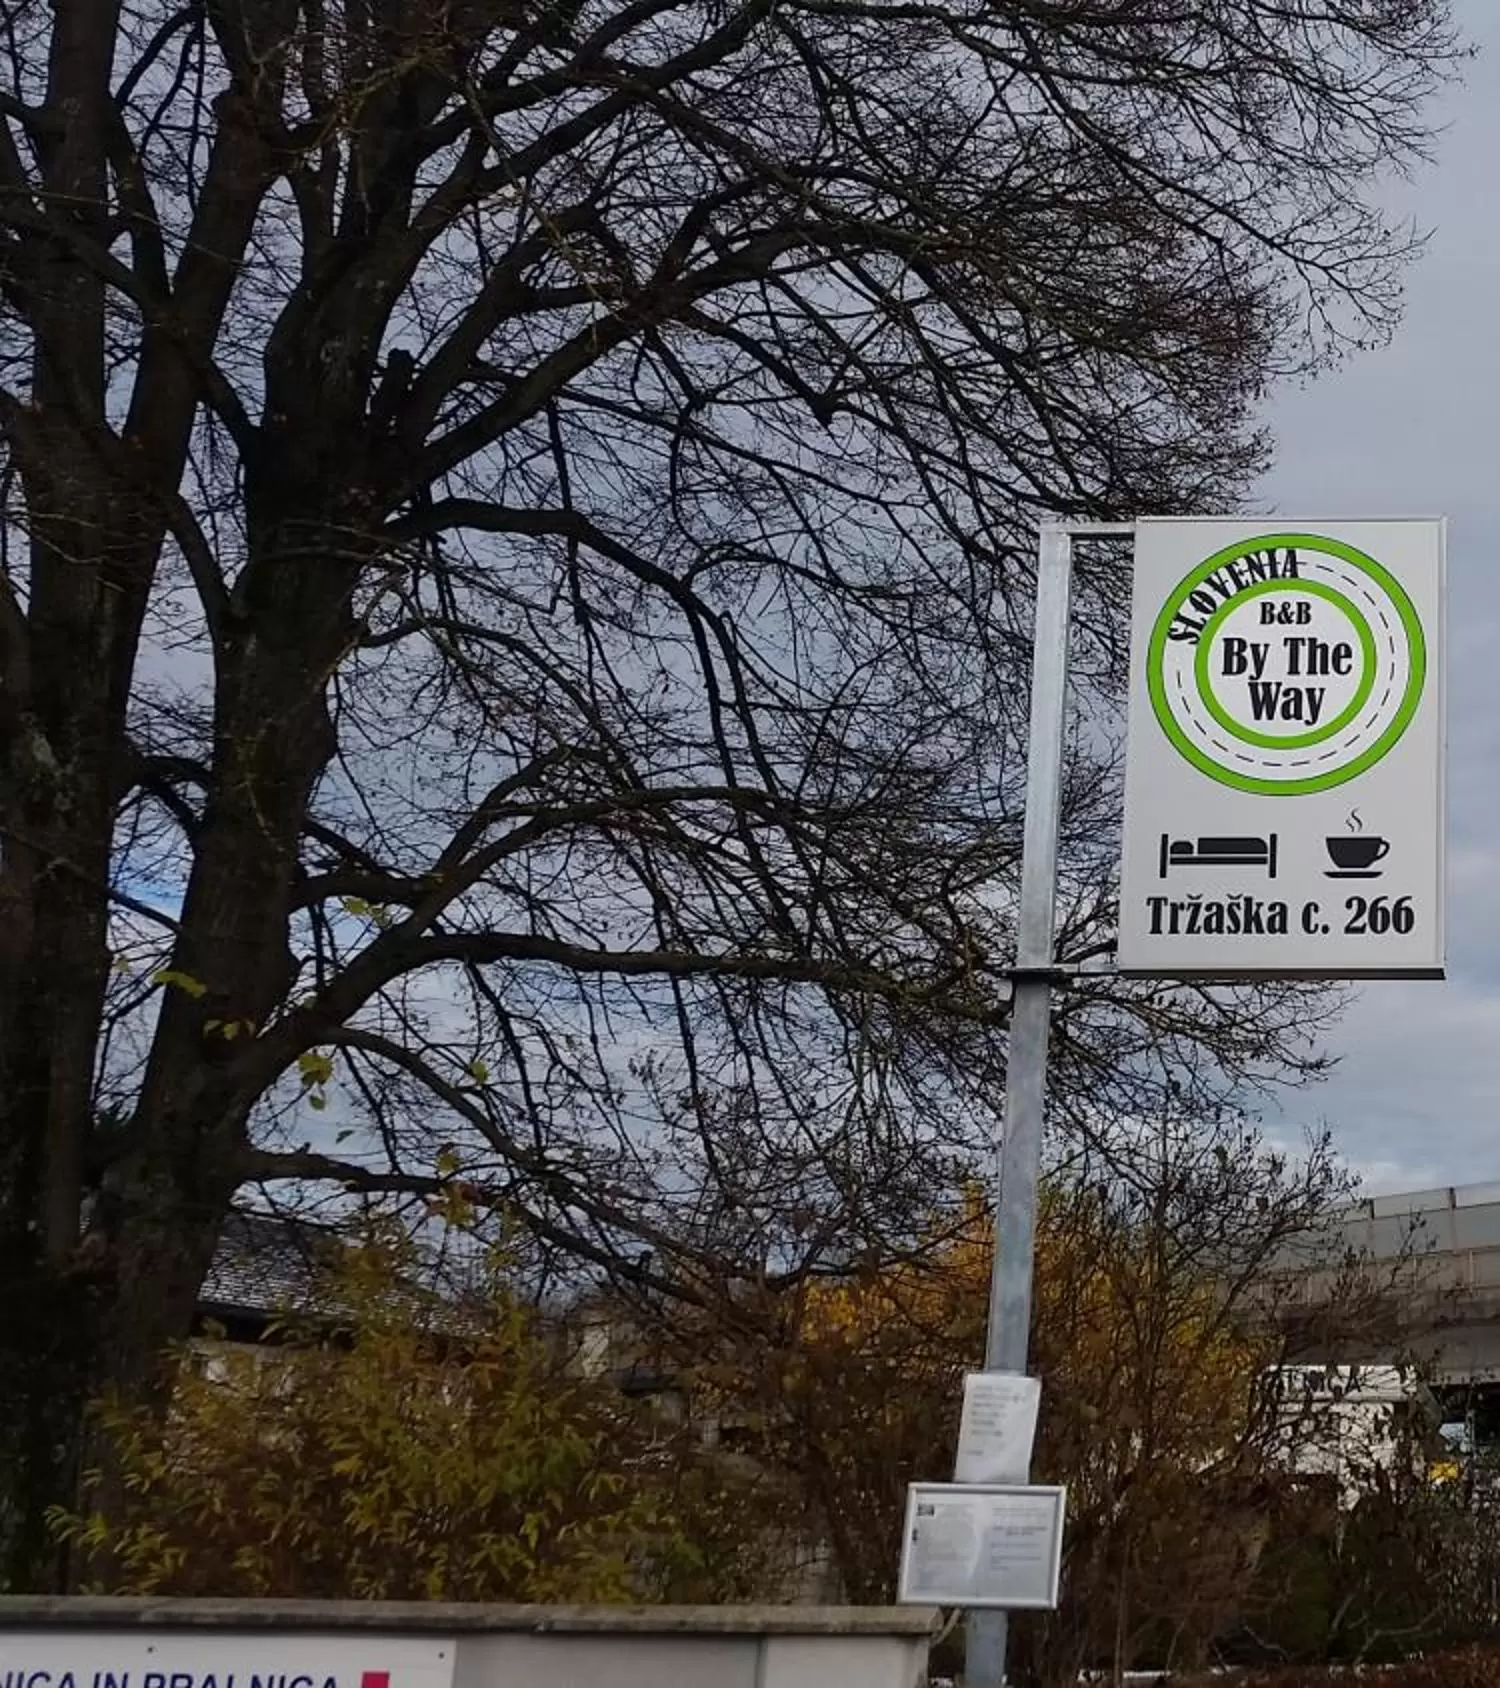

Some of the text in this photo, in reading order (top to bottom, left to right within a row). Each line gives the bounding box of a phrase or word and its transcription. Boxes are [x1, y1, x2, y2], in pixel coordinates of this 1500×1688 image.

[1167, 547, 1299, 645] SLOVENIA
[1259, 601, 1312, 626] B&B
[1222, 637, 1353, 680] By The
[1248, 680, 1326, 726] Way
[1146, 893, 1415, 935] Tržaška c. 266
